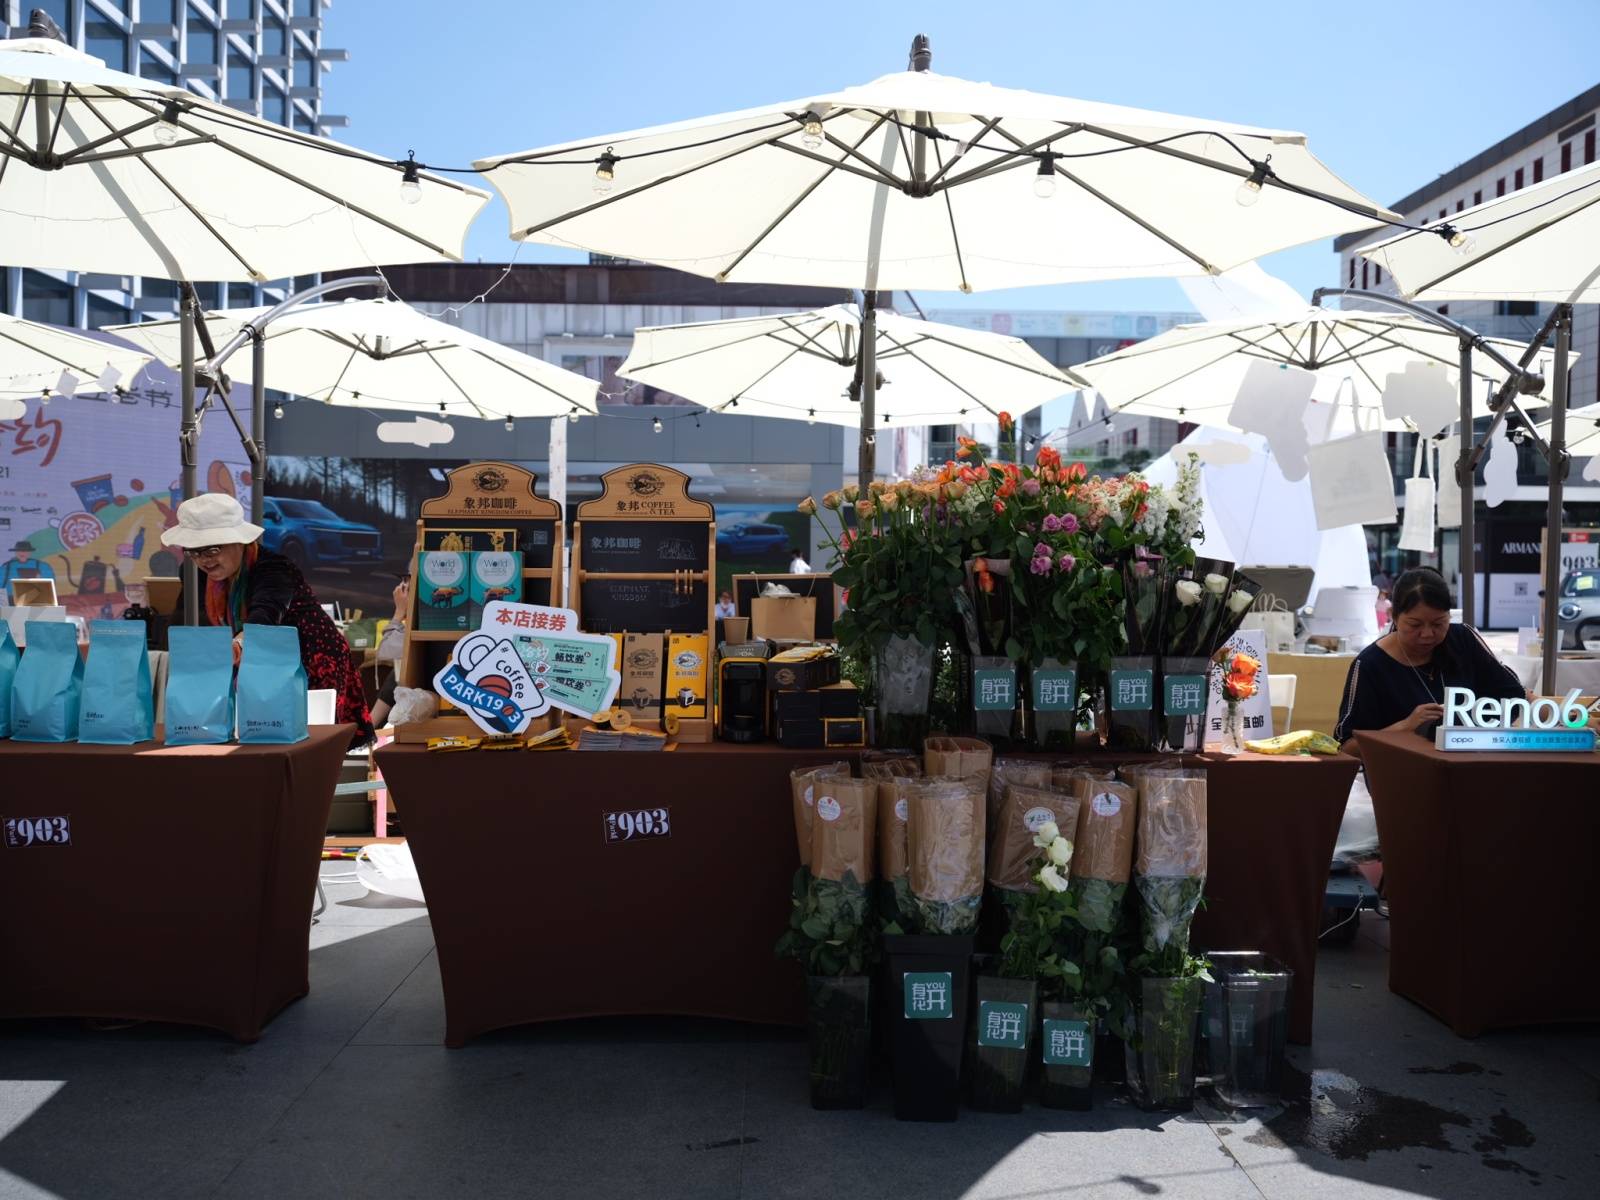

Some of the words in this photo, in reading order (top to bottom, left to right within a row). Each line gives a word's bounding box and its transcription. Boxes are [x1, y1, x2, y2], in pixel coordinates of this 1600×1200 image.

[464, 497, 518, 509] 象邦咖啡
[617, 501, 640, 511] 象邦
[496, 608, 567, 631] 本店接券
[496, 660, 525, 699] Coffee
[1445, 686, 1589, 729] Reno6
